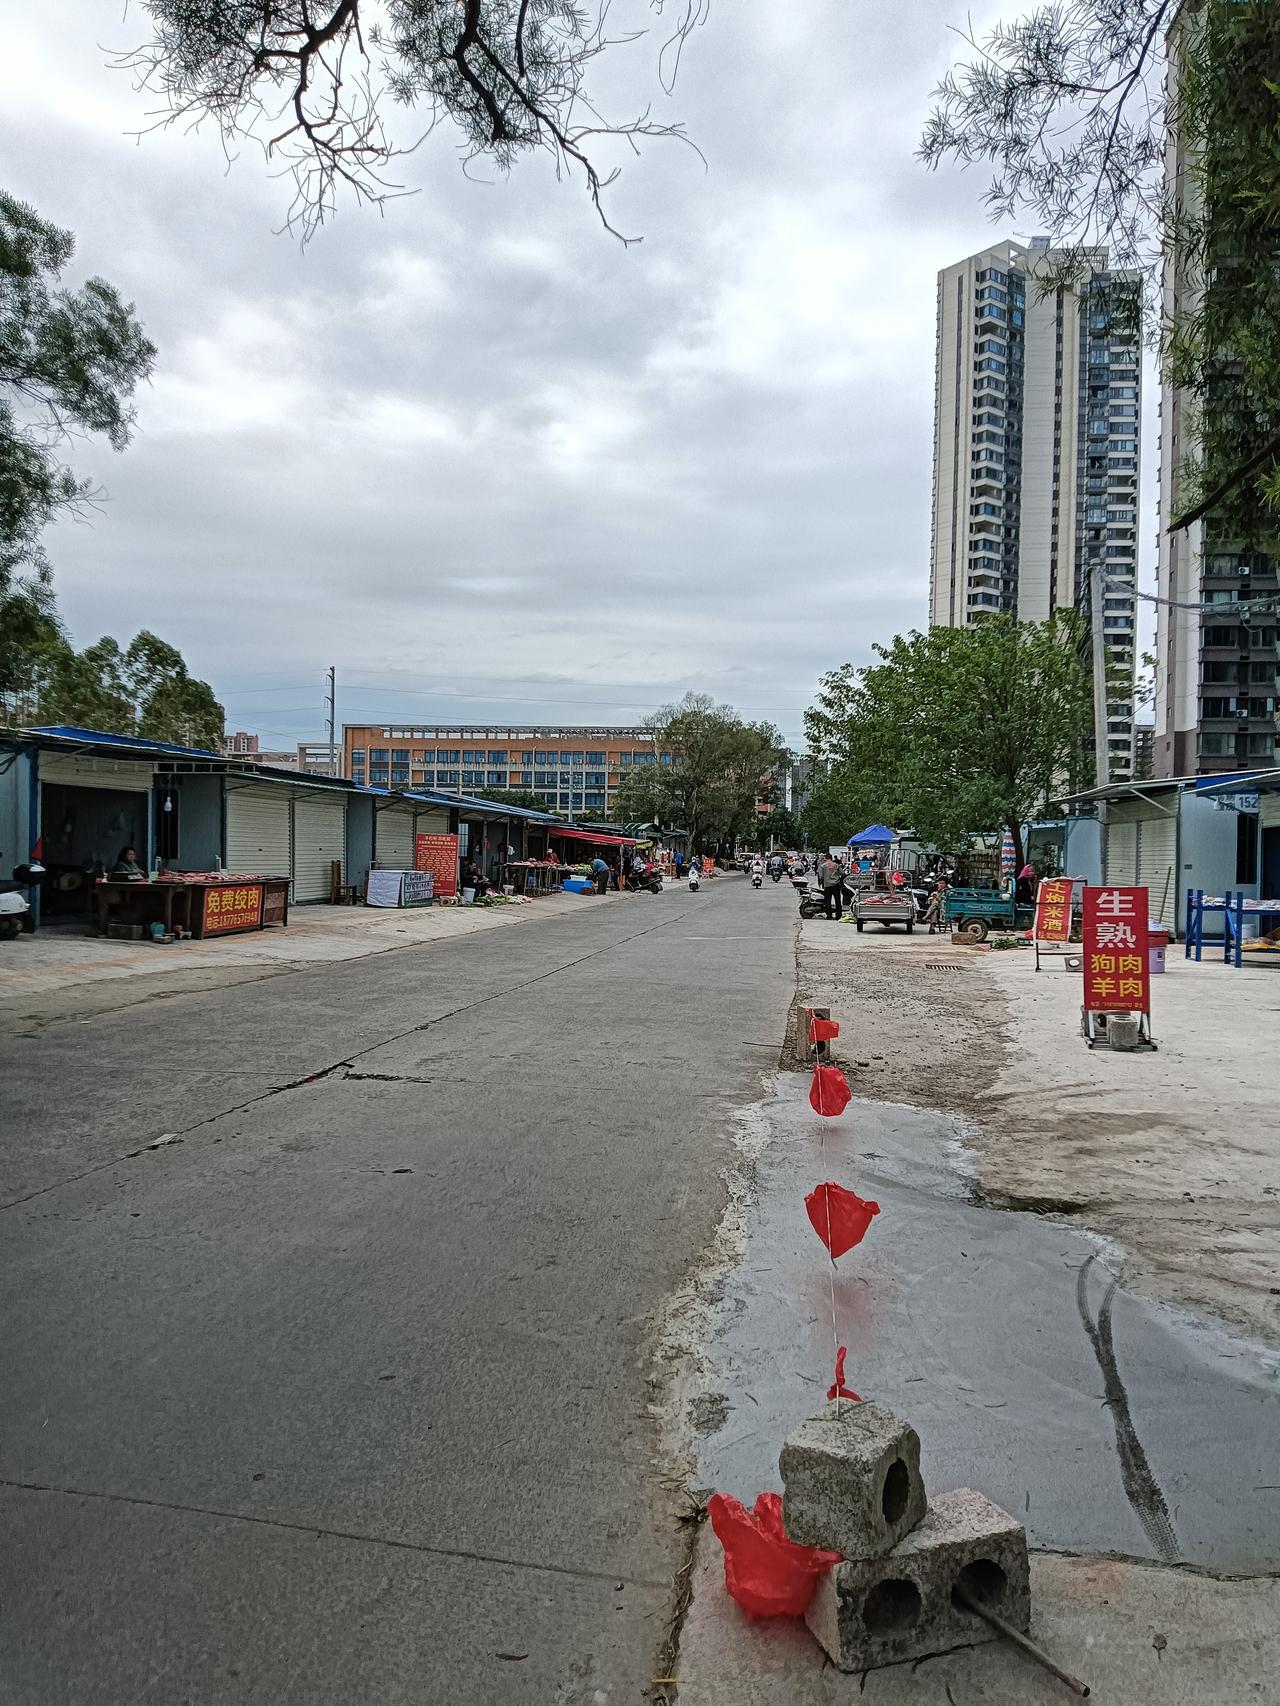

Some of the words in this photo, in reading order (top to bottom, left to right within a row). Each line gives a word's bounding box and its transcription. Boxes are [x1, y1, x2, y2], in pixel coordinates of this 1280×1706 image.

[1238, 796, 1258, 809] 152
[207, 888, 259, 913] 免费绞肉
[1091, 954, 1143, 975] 狗肉
[1091, 977, 1143, 997] 羊肉
